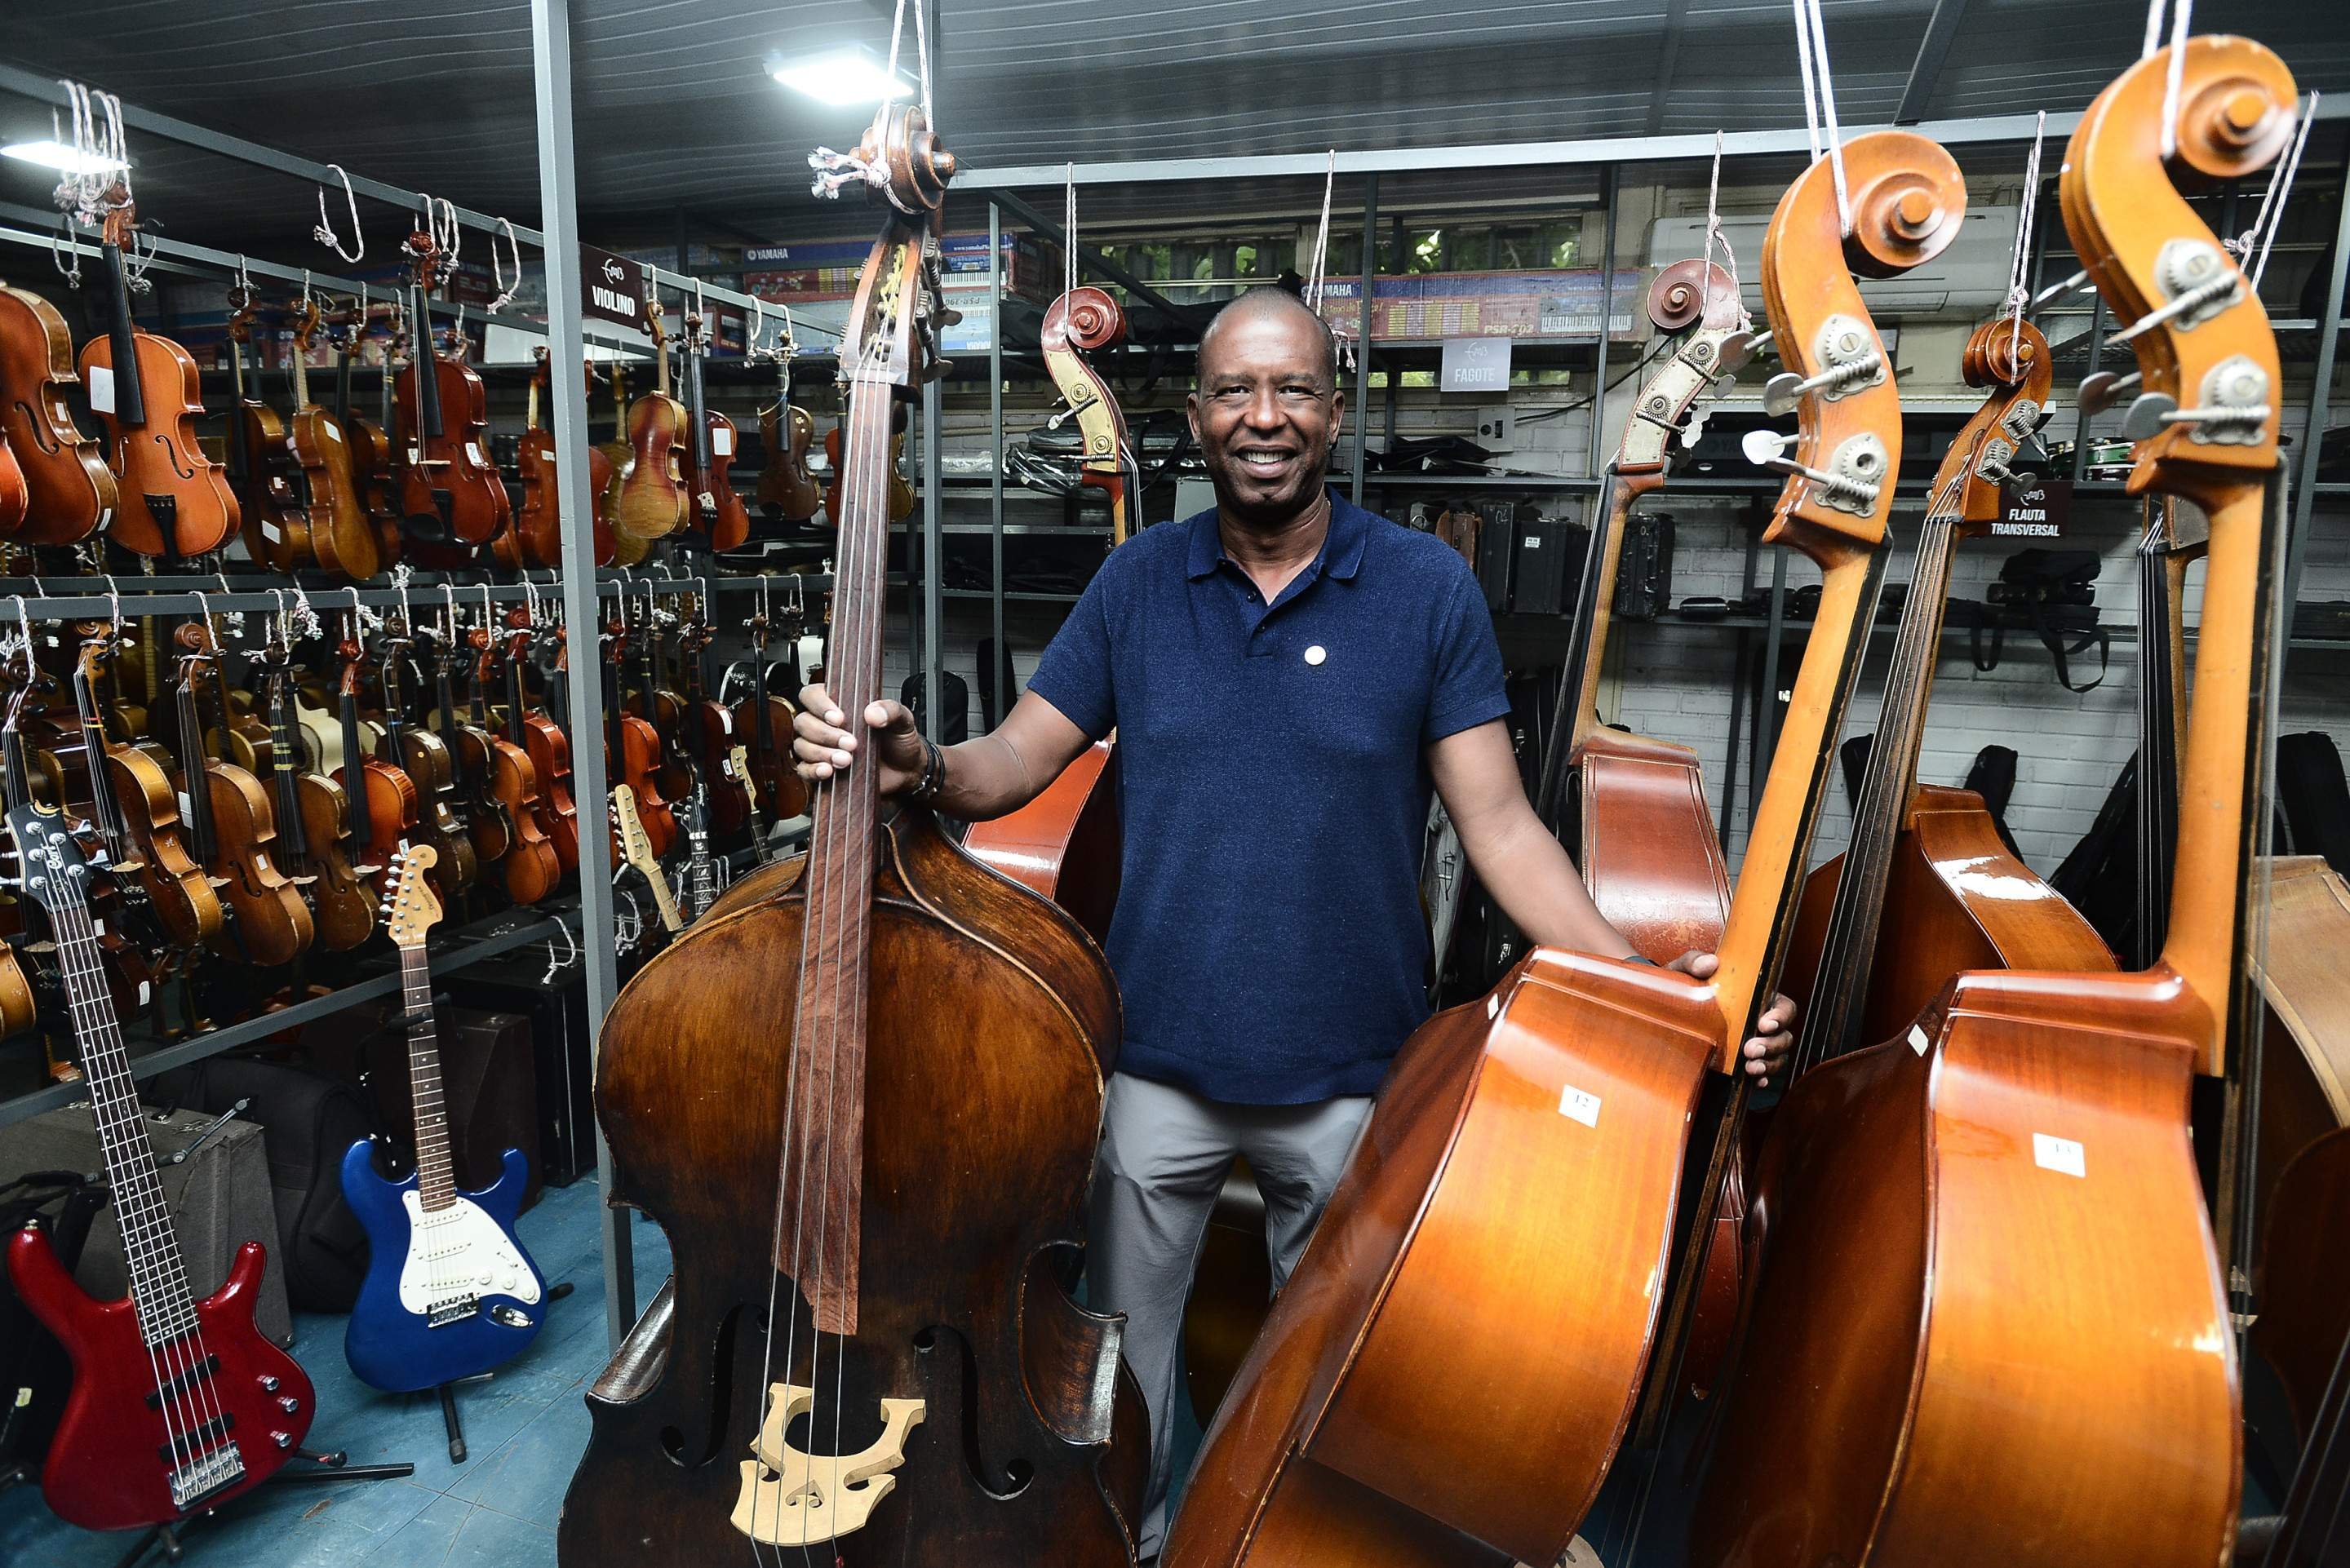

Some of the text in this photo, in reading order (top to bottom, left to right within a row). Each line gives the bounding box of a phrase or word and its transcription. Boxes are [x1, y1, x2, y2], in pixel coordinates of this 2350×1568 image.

[756, 247, 788, 260] YAMAHA
[1313, 284, 1353, 296] YMAHA
[592, 285, 636, 317] VIOLINO
[1454, 367, 1496, 383] FAGOTE
[2008, 508, 2046, 520] FLAUTA
[1991, 523, 2060, 537] TRANSVERSAL
